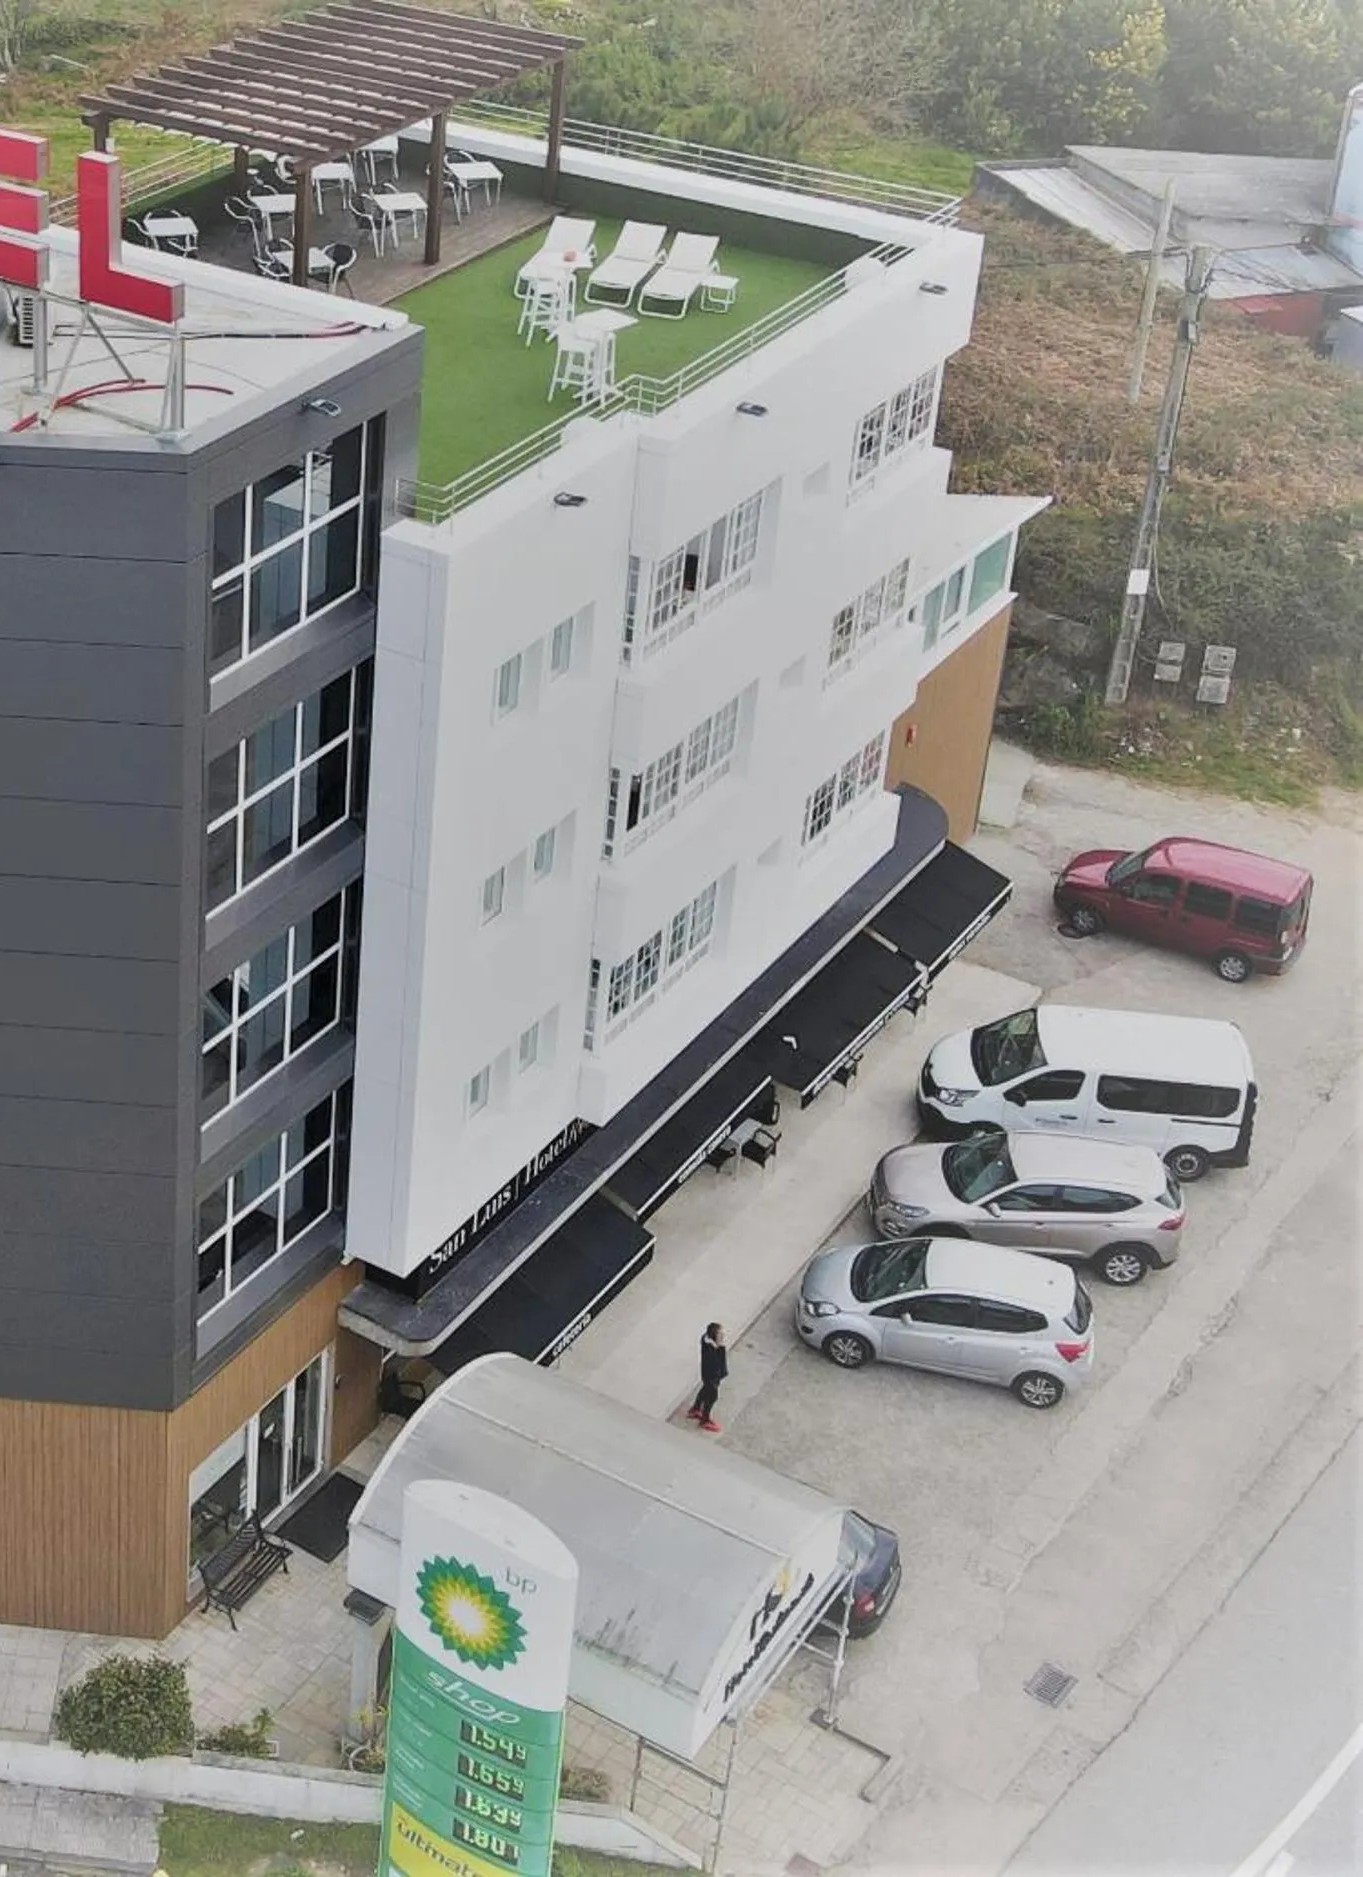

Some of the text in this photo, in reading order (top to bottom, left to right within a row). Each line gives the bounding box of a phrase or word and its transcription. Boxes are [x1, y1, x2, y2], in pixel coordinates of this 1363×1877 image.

[429, 1229, 466, 1274] San
[524, 1125, 568, 1185] Hotel
[505, 1566, 537, 1595] bp
[427, 1671, 521, 1723] shop
